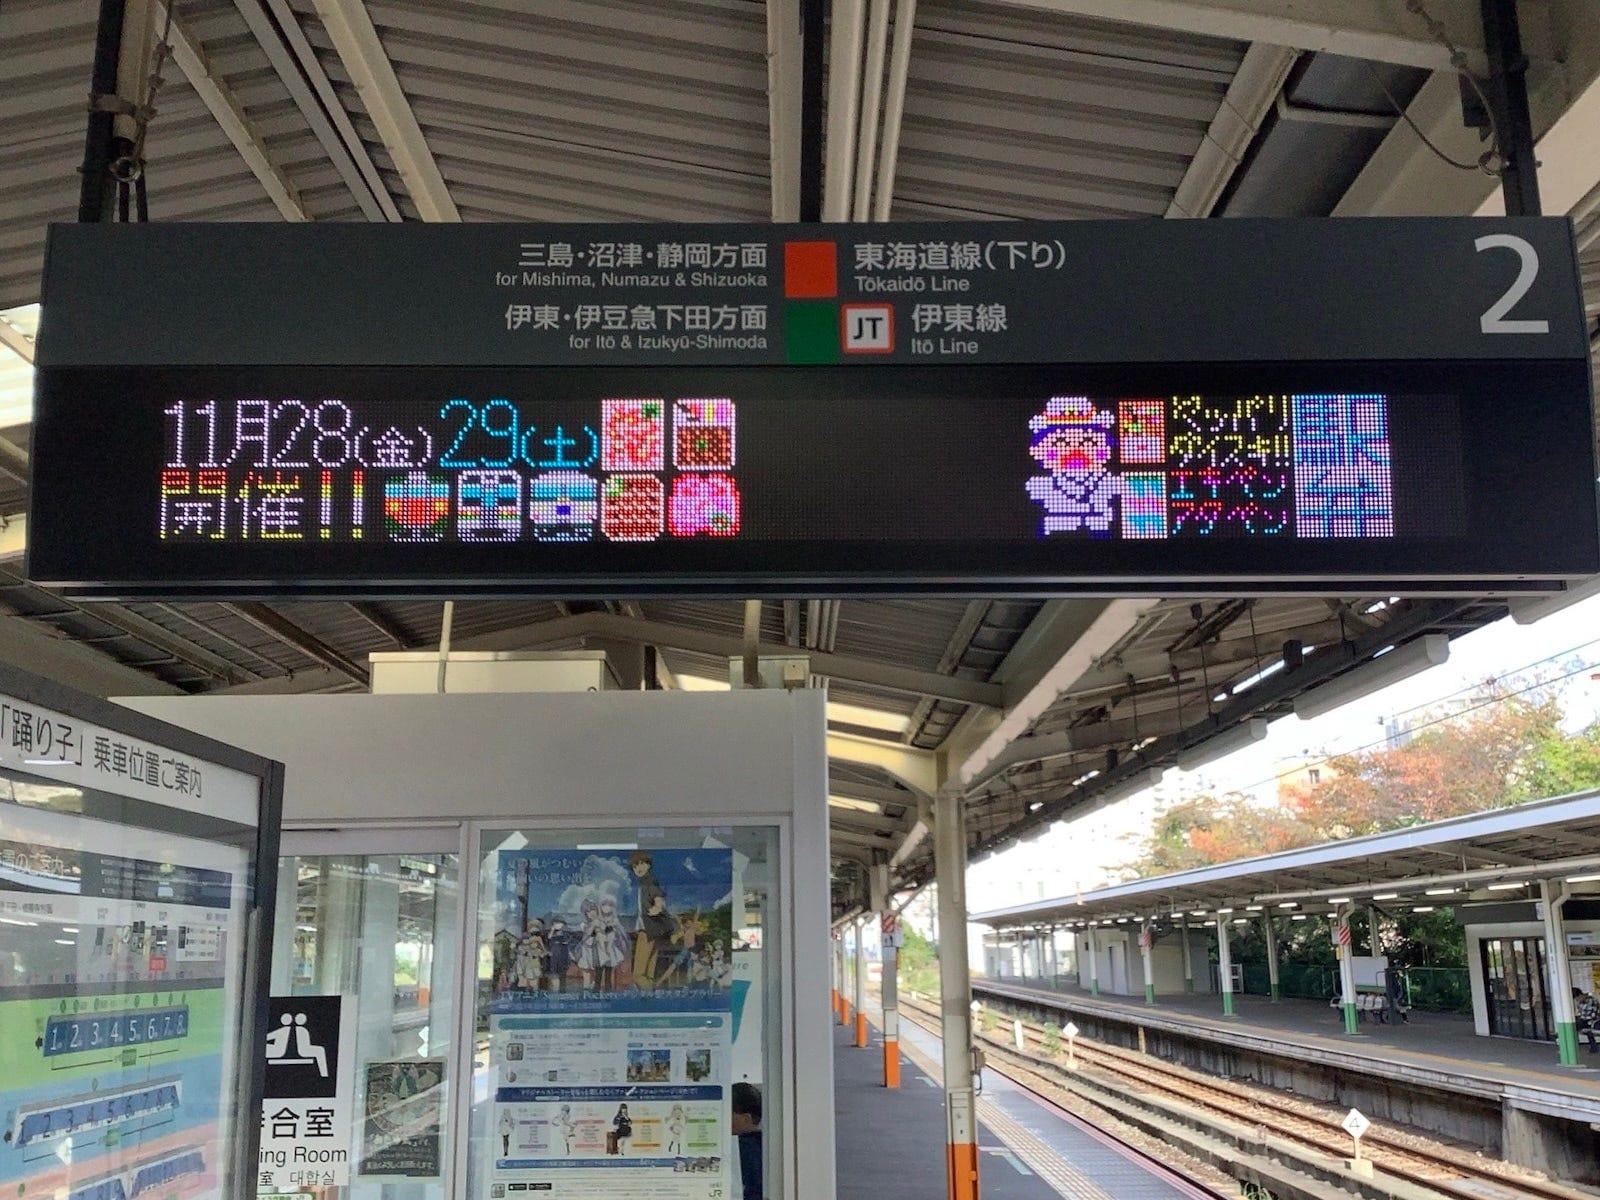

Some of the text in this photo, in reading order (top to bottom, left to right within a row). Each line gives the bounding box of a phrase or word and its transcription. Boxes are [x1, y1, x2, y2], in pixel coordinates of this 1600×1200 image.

[518, 242, 768, 269] 三島・沼津・静岡方面
[853, 240, 1066, 271] 東海道線(下り)
[495, 271, 768, 288] for Mishima, Numazu & Shizuoka
[854, 275, 970, 292] Tōkaidō Line
[1474, 233, 1550, 334] 2
[504, 304, 768, 330] 伊東・伊豆急下田方面
[911, 303, 1008, 332] 伊東線
[853, 316, 884, 340] JT
[569, 334, 591, 349] for
[620, 335, 632, 349] &
[940, 338, 979, 354] Line
[293, 1146, 347, 1163] Room
[259, 1171, 274, 1187] 室
[289, 1169, 335, 1186] 대합실
